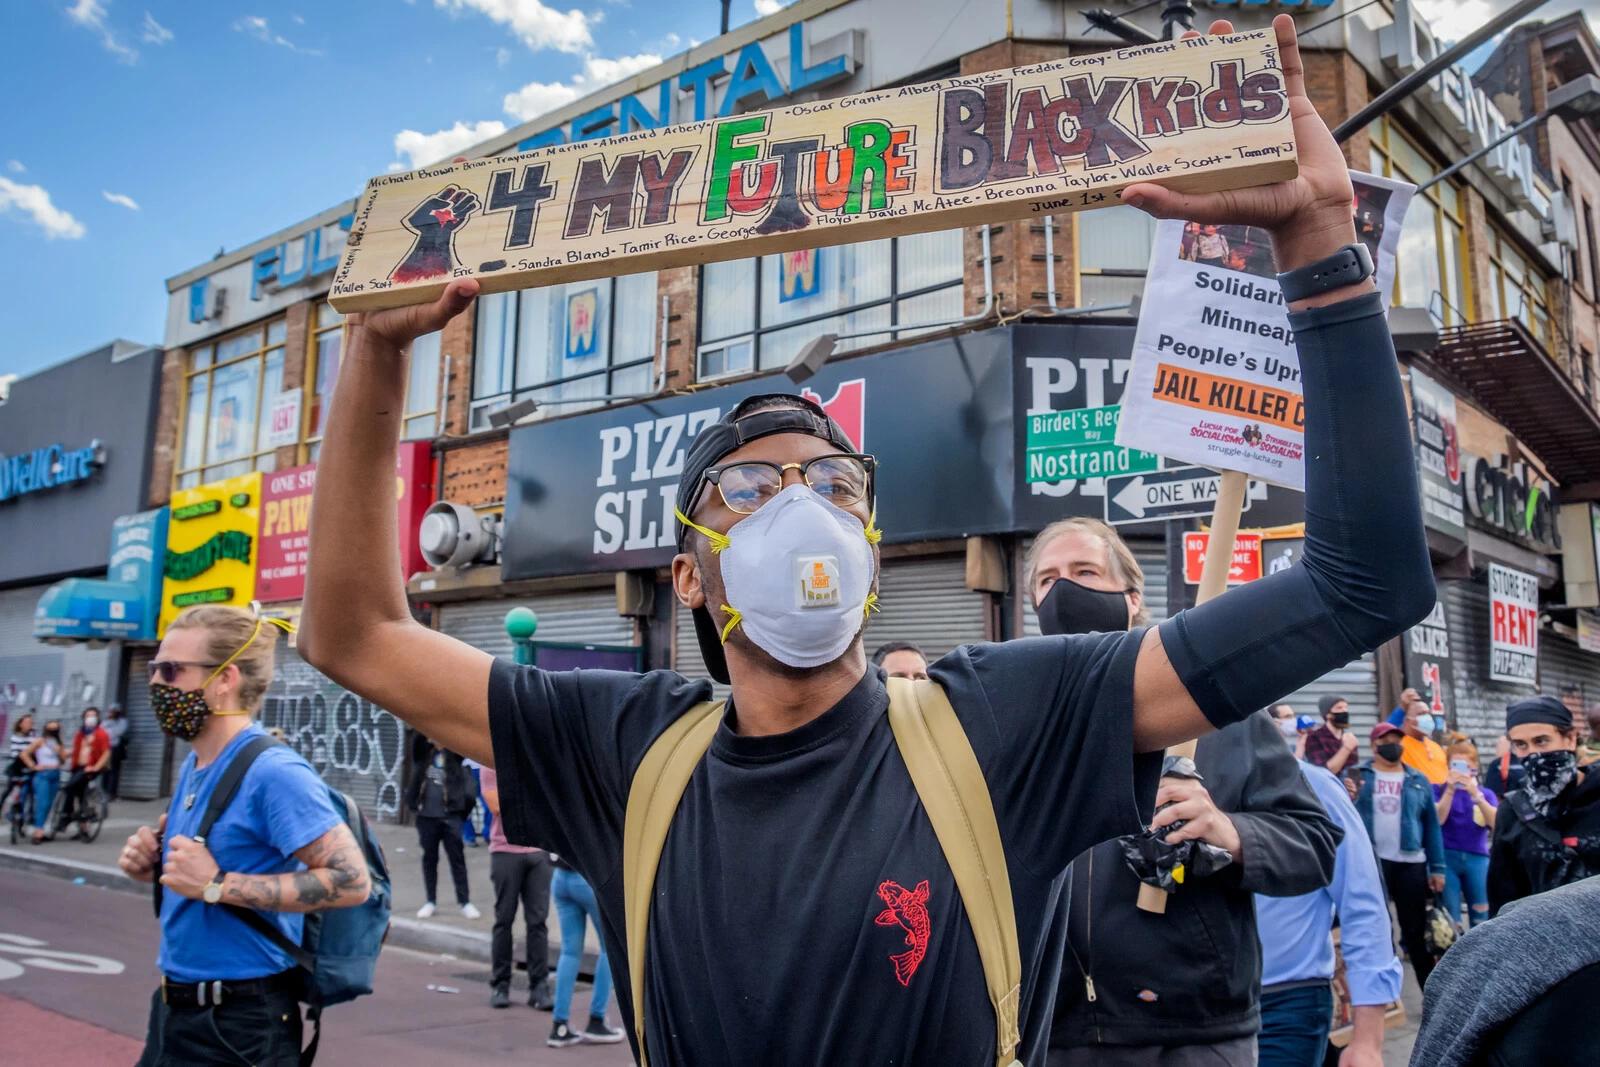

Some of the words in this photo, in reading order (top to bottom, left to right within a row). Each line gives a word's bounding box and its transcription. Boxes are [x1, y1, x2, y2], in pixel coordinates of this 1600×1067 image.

[518, 21, 850, 151] ENTAL
[367, 174, 414, 189] Michael
[494, 151, 539, 166] Trayvon
[546, 142, 588, 156] Martin
[898, 83, 942, 97] Albert
[1012, 62, 1064, 77] Freddie
[1117, 43, 1176, 60] Emmett
[1218, 31, 1266, 45] Yvette
[483, 161, 558, 250] 4
[562, 145, 701, 240] MY
[697, 112, 917, 230] FUTURE
[333, 282, 364, 294] Wallet
[370, 279, 393, 290] Scott
[453, 267, 474, 278] Eric
[619, 239, 662, 255] Tamir
[708, 225, 757, 240] George
[868, 205, 908, 220] David
[985, 183, 1057, 200] Breonna
[1119, 162, 1171, 179] Wallet
[1281, 142, 1294, 152] J
[1028, 198, 1073, 212] June
[1080, 192, 1106, 206] 1st
[1195, 271, 1284, 306] Solidari
[1201, 306, 1296, 347] Minneap
[1158, 334, 1257, 372] People's
[1264, 356, 1301, 382] Upr
[1153, 370, 1201, 403] JAIL
[1208, 380, 1289, 422] KILLER
[1033, 411, 1090, 434] Birdel's
[1095, 409, 1120, 427] Rec
[1190, 426, 1245, 445] SOCIALISMO
[1030, 447, 1130, 478] Nostrand
[1208, 443, 1283, 469] struggle-la-lucha.org
[1260, 441, 1303, 461] SOCIALISM
[271, 475, 296, 494] ONE
[1147, 484, 1184, 505] ONE
[1191, 478, 1221, 500] WA
[263, 494, 313, 537] PAW
[593, 483, 678, 555] SLI
[1188, 540, 1204, 550] NO
[1492, 567, 1520, 599] STORE
[1493, 600, 1537, 649] RENT
[1411, 626, 1449, 658] SLICE
